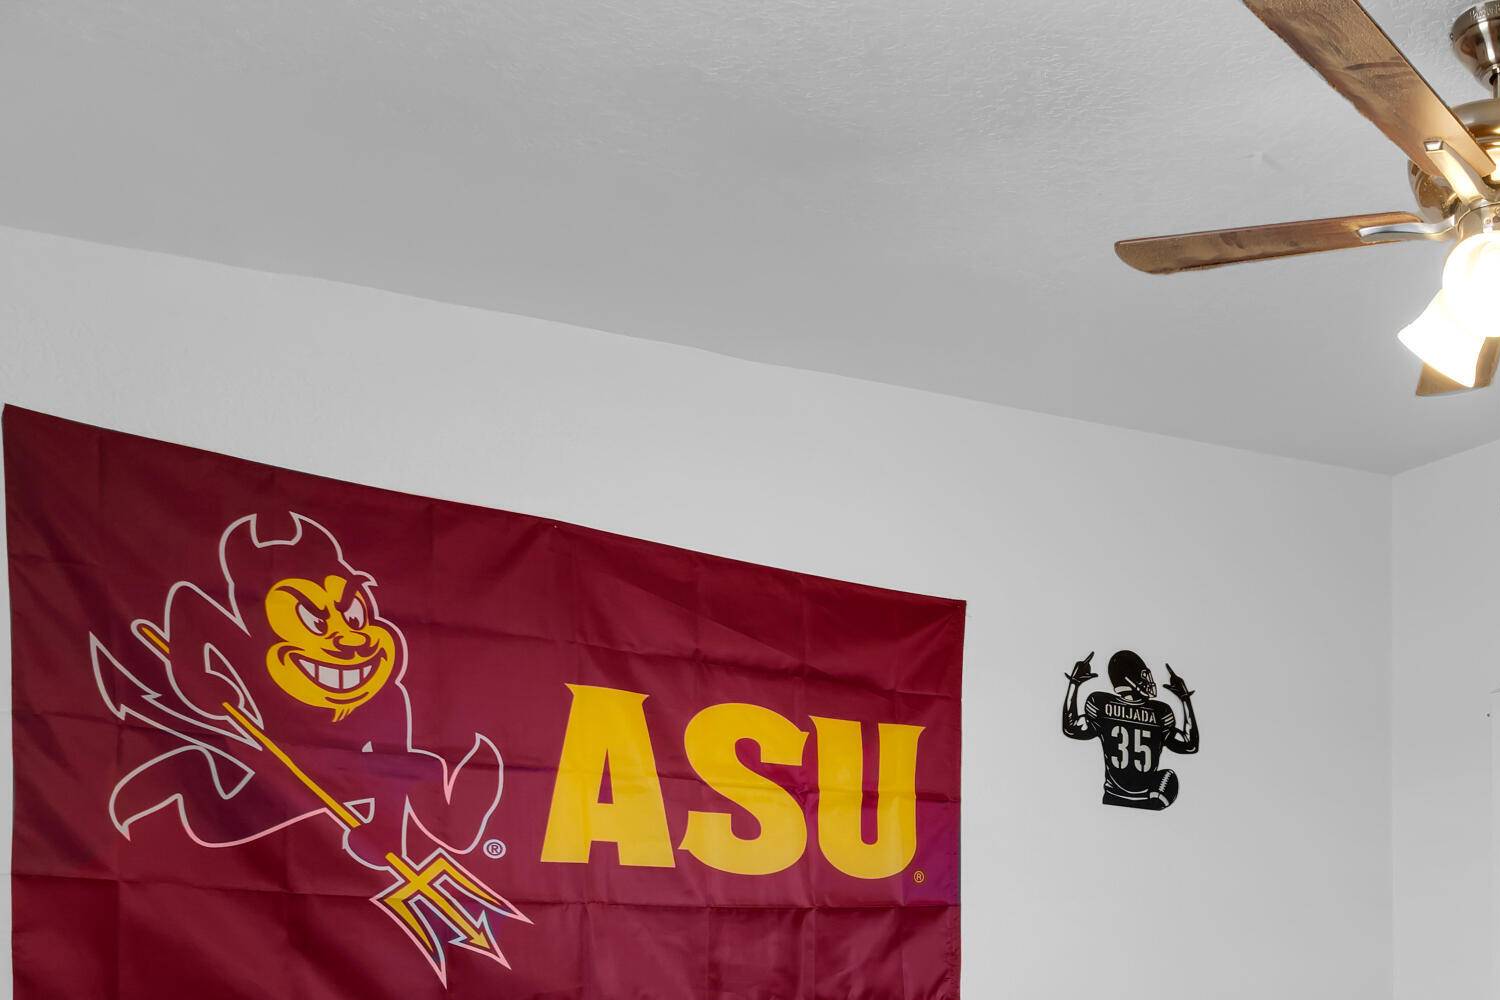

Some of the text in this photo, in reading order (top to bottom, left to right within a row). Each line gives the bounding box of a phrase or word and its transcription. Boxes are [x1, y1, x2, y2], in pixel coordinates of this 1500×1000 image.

[1105, 703, 1157, 724] QUIJADA
[1110, 725, 1152, 773] 35
[540, 682, 927, 880] ASU
